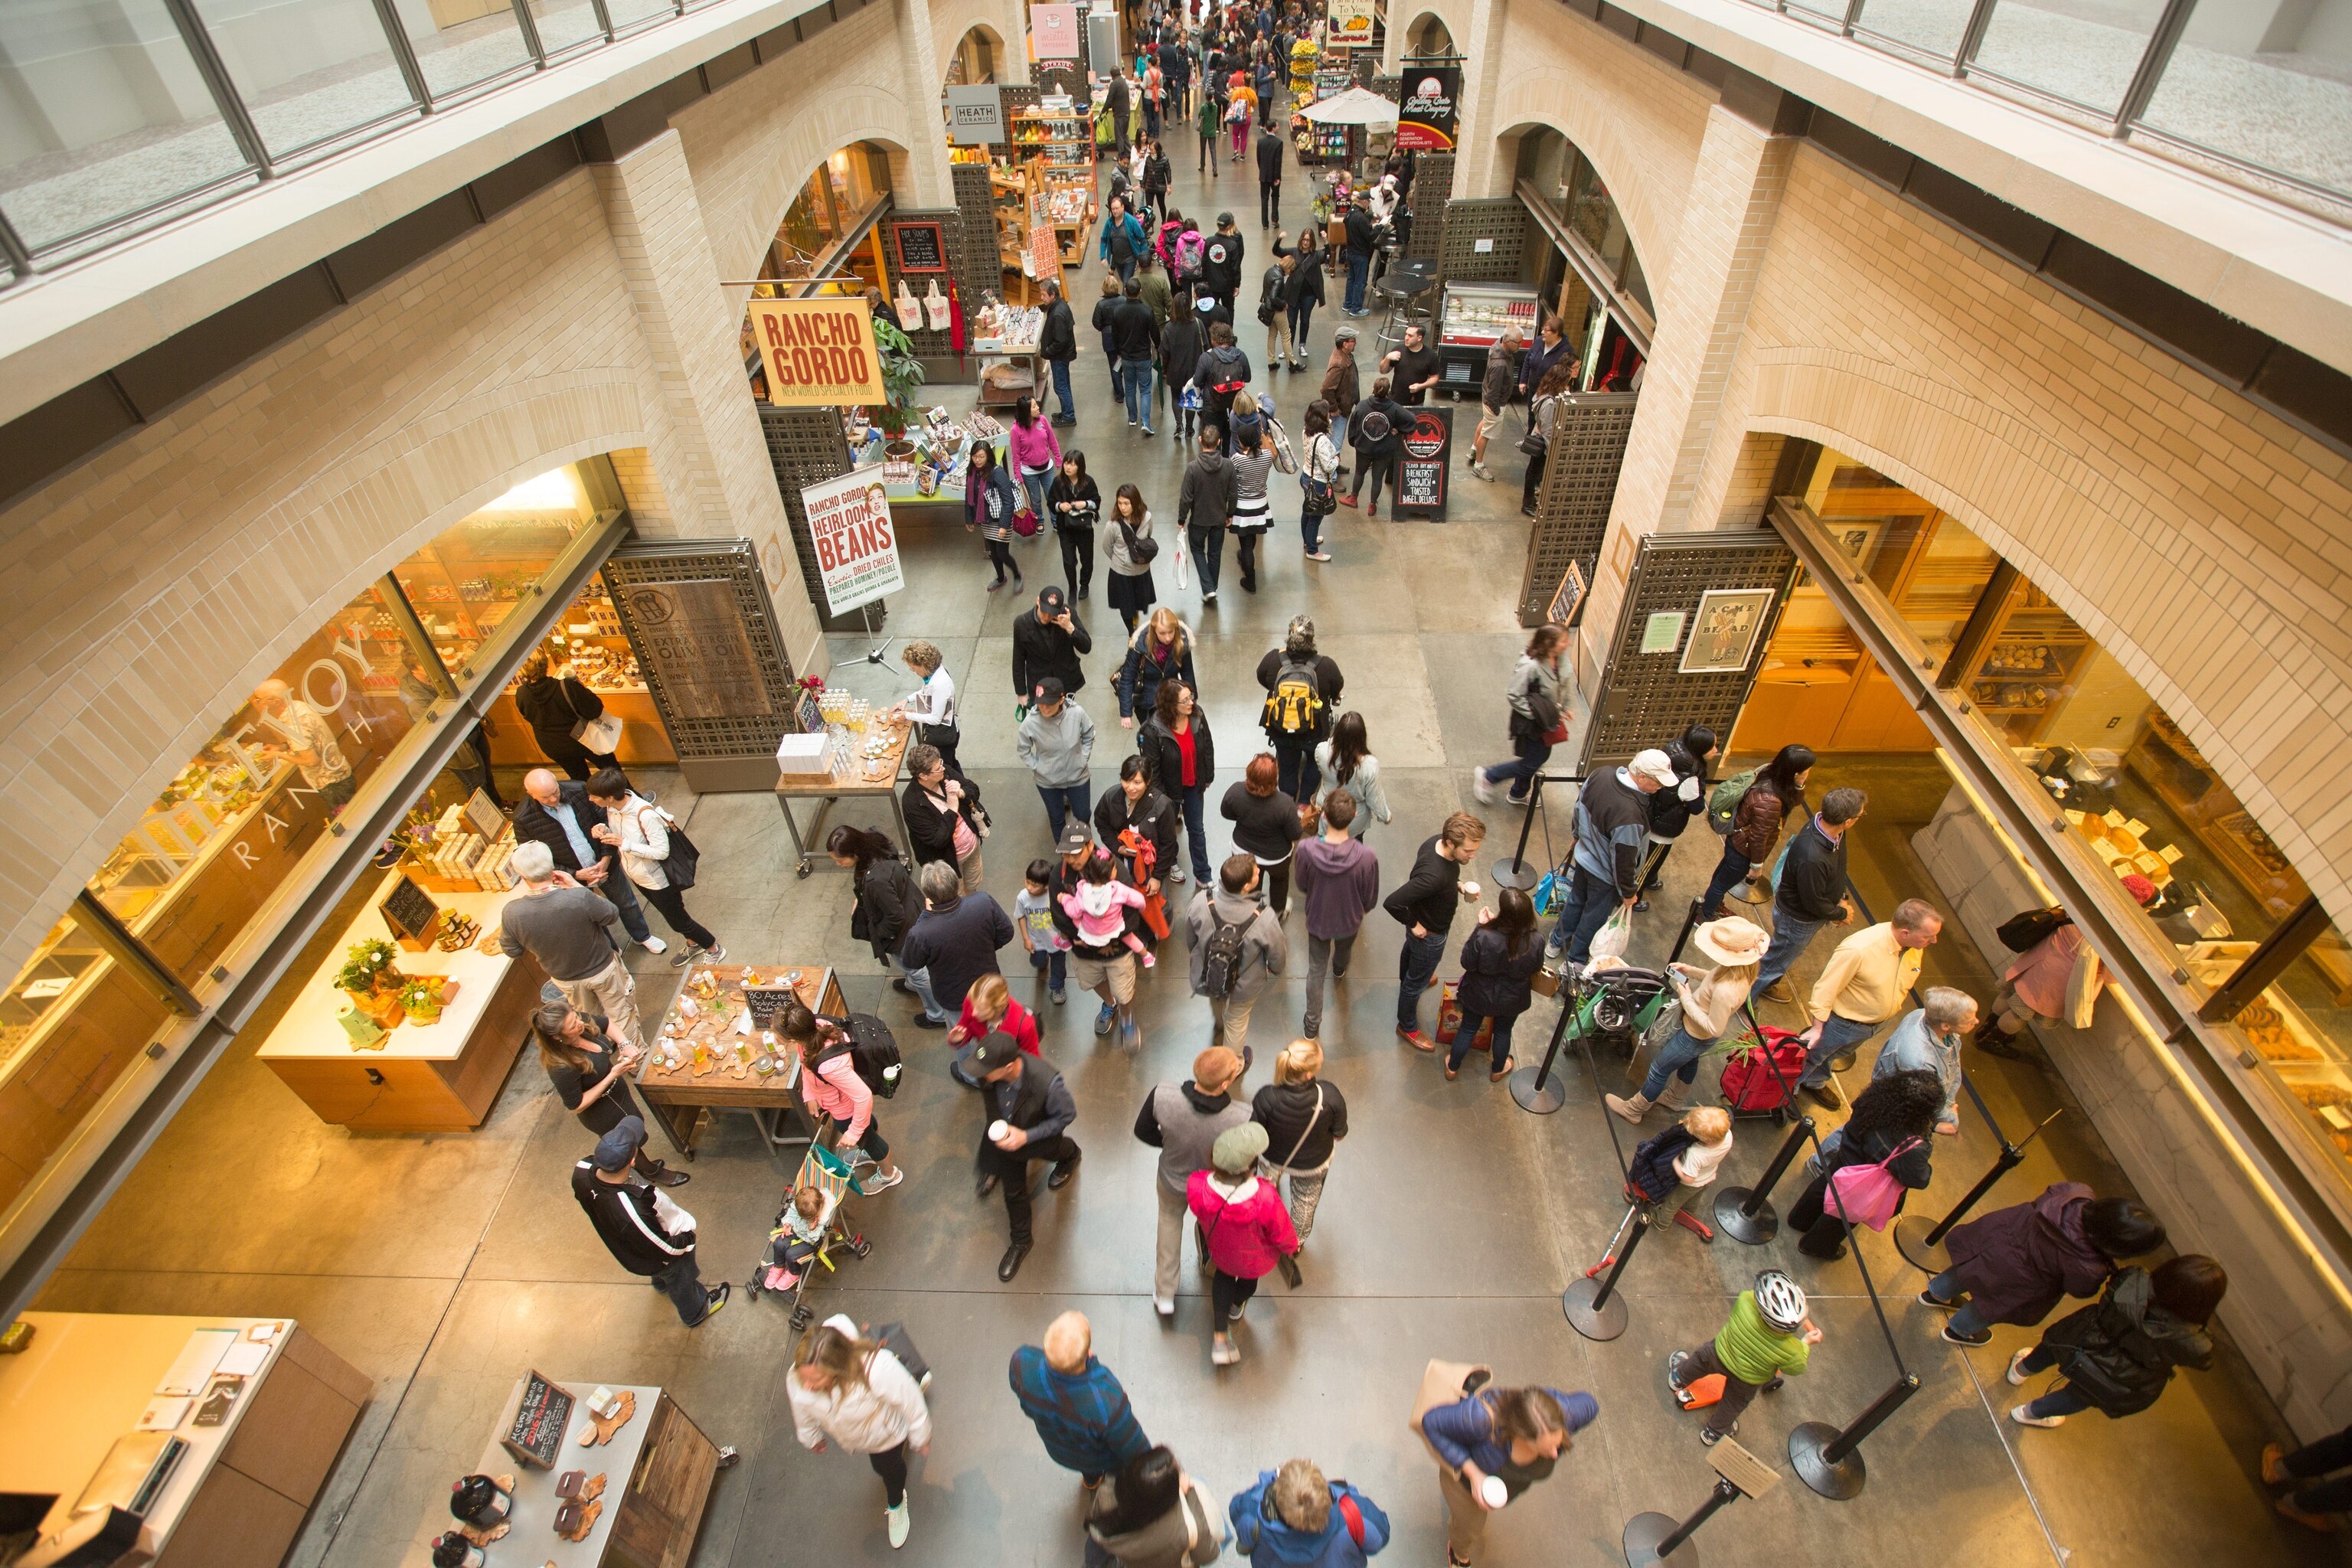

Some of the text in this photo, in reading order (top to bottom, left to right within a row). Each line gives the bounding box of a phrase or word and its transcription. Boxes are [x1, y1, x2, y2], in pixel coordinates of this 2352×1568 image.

[1338, 5, 1365, 13] To You
[1041, 31, 1070, 41] miette
[959, 108, 993, 116] HEATH
[763, 312, 861, 347] RANCHO
[773, 346, 869, 385] GORDO
[782, 385, 872, 397] NEW WORLD SPECIALTY FOOD
[1406, 469, 1434, 478] BREAKFAST
[1407, 478, 1431, 487] SANDWICH
[1410, 487, 1431, 495] TOASTED
[808, 495, 839, 515] RANCHO
[841, 486, 866, 504] GORDO
[1403, 495, 1437, 504] BAGEL DELUXE
[813, 504, 871, 537] HEIRLOOM
[817, 517, 891, 572] BEANS
[828, 554, 893, 586] Exotic DRIED CHILES
[829, 580, 854, 595] PREPARED
[852, 590, 865, 598] GRAINS
[1708, 604, 1756, 614] ACME
[1702, 624, 1749, 634] BRAD
[654, 634, 740, 646] EXTRA VIRGIN
[658, 644, 746, 658] OLIVE OIL
[233, 711, 372, 871] RANCH
[748, 991, 792, 1000] 80 Acres
[511, 1380, 538, 1441] McEvoy Ranch
[518, 1427, 530, 1446] Extra
[532, 1394, 542, 1407] Olive
[526, 1419, 539, 1446] 2016
